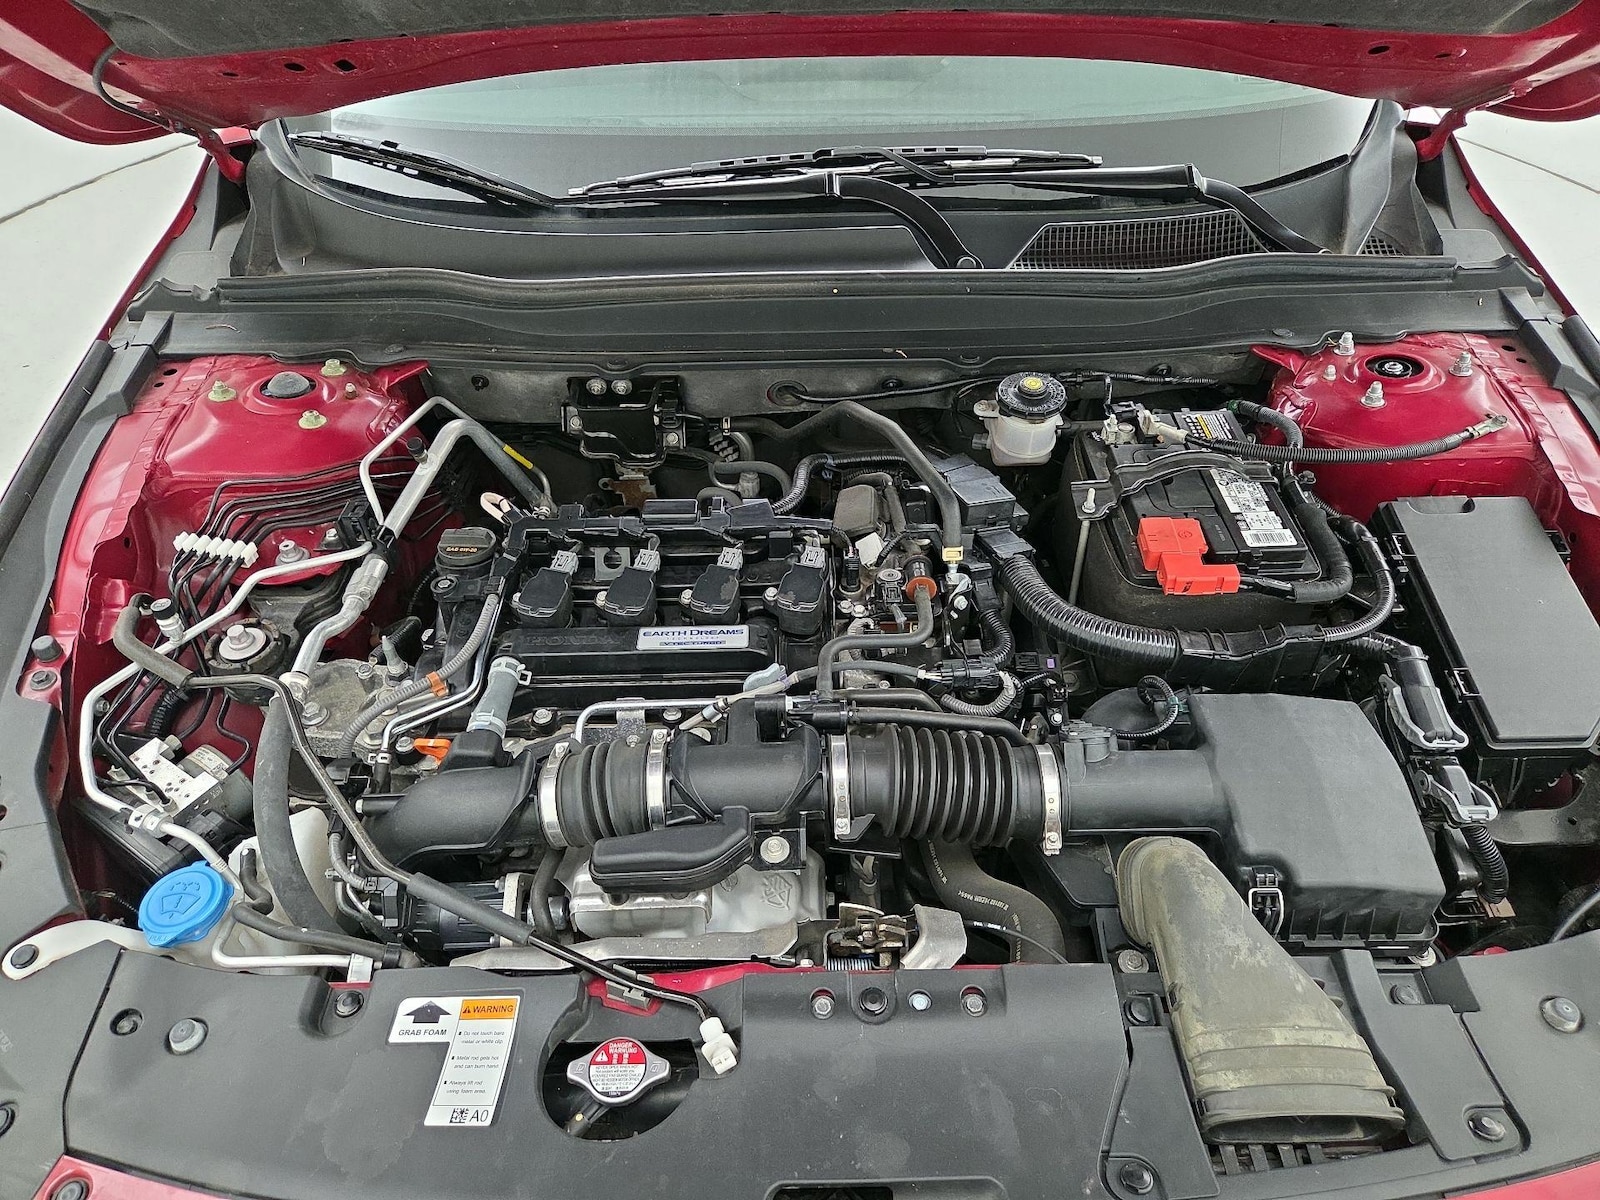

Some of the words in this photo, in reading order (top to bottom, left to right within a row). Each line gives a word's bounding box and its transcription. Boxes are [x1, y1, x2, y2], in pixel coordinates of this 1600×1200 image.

[690, 628, 744, 636] DREAMS
[526, 635, 621, 646] HONDA
[472, 1005, 514, 1014] WARNING
[423, 1028, 447, 1036] FOAM
[468, 1109, 489, 1123] A0
